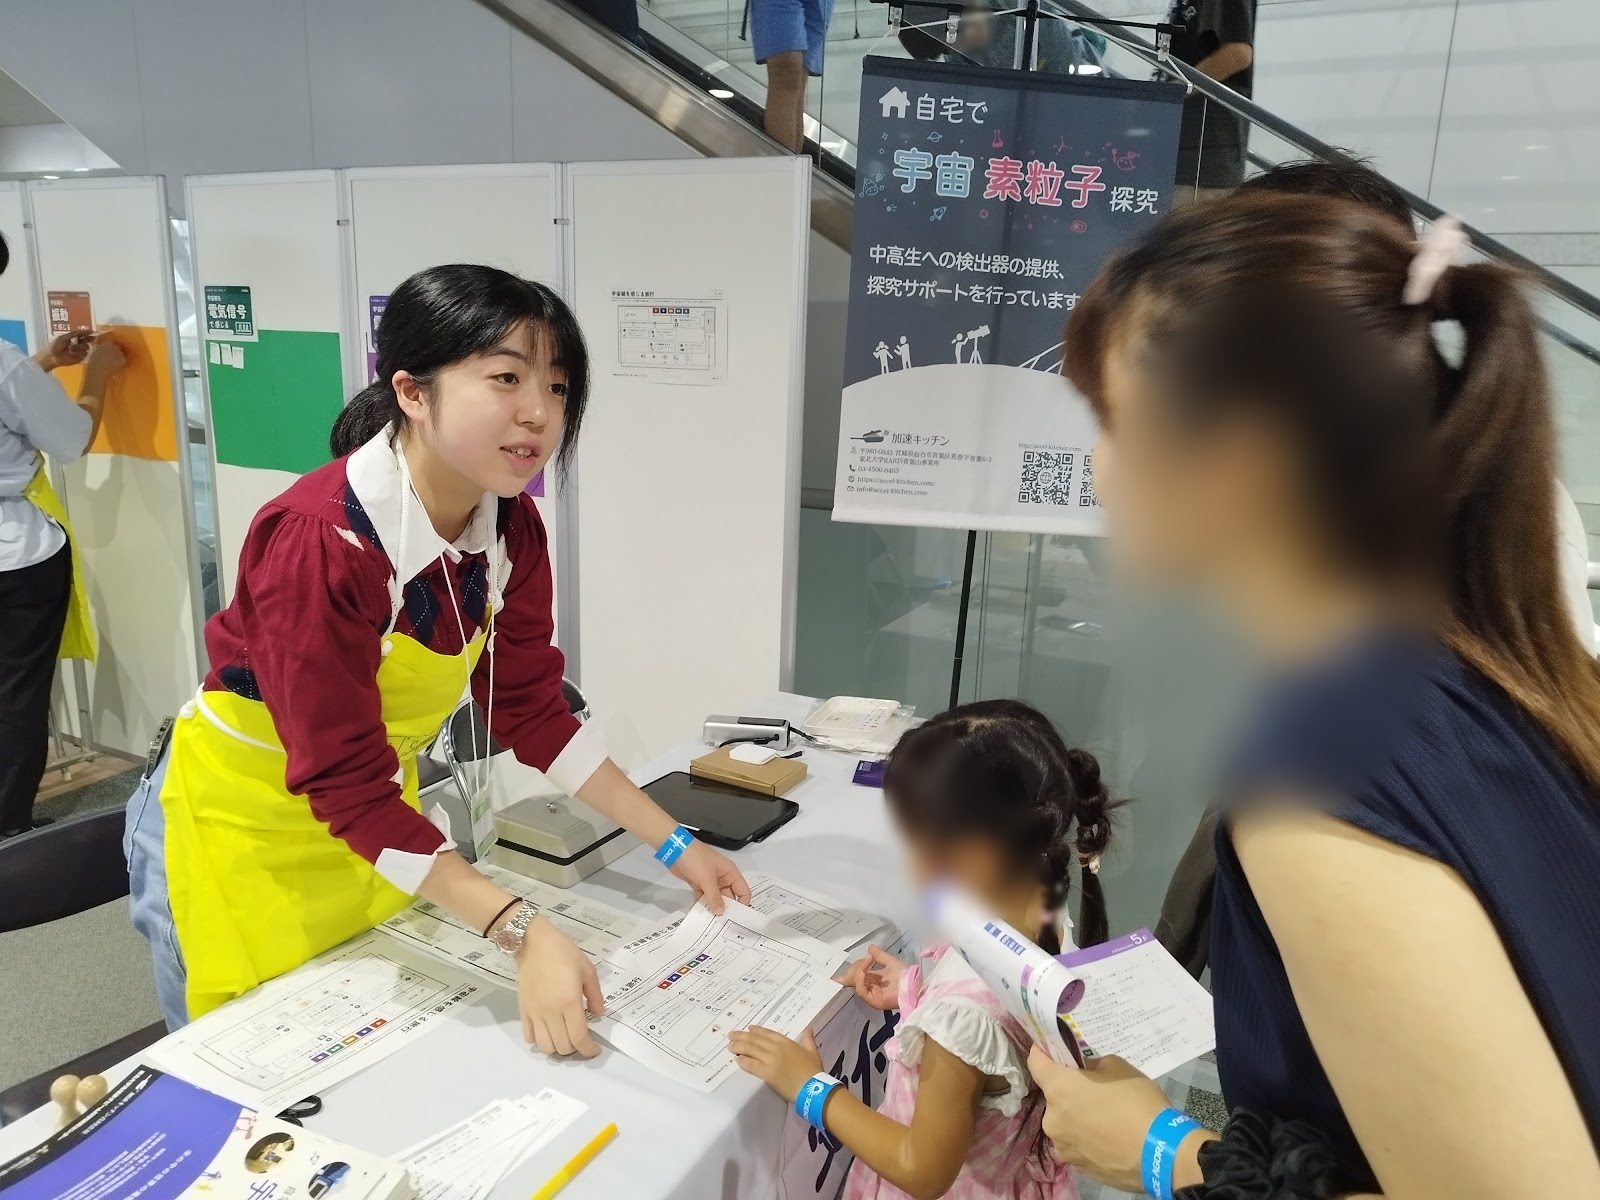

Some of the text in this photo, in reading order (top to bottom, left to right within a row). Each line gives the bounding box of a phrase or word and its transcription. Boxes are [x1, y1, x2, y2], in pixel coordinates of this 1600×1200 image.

[916, 94, 988, 124] 自宅で
[893, 148, 1159, 214] 宇宙 素粒子 探究
[869, 244, 1065, 279] 中高生への検出器の提供、
[207, 303, 247, 320] 電気信号
[209, 321, 229, 329] で感じる
[891, 433, 950, 446] 加速キッチン
